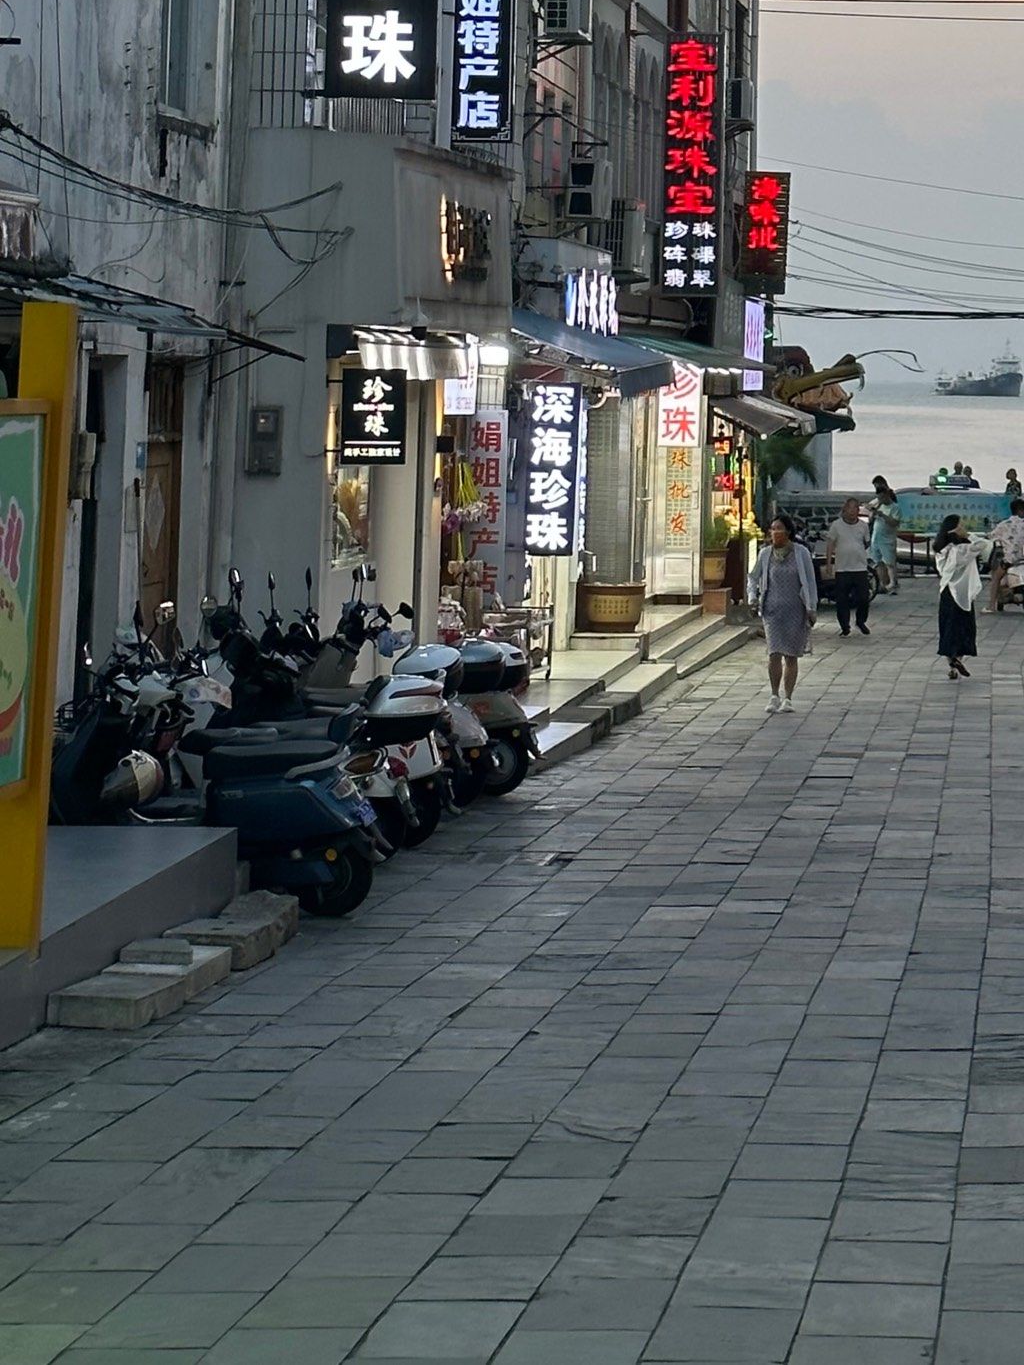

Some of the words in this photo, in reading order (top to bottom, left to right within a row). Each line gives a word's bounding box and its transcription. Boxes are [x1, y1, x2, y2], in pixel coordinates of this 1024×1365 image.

[665, 39, 717, 215] 宝利源珠宝
[664, 221, 717, 240] 珍珠
[664, 269, 715, 289] 翡翠
[662, 362, 699, 442] 珍珠
[525, 385, 575, 551] 深海珍珠
